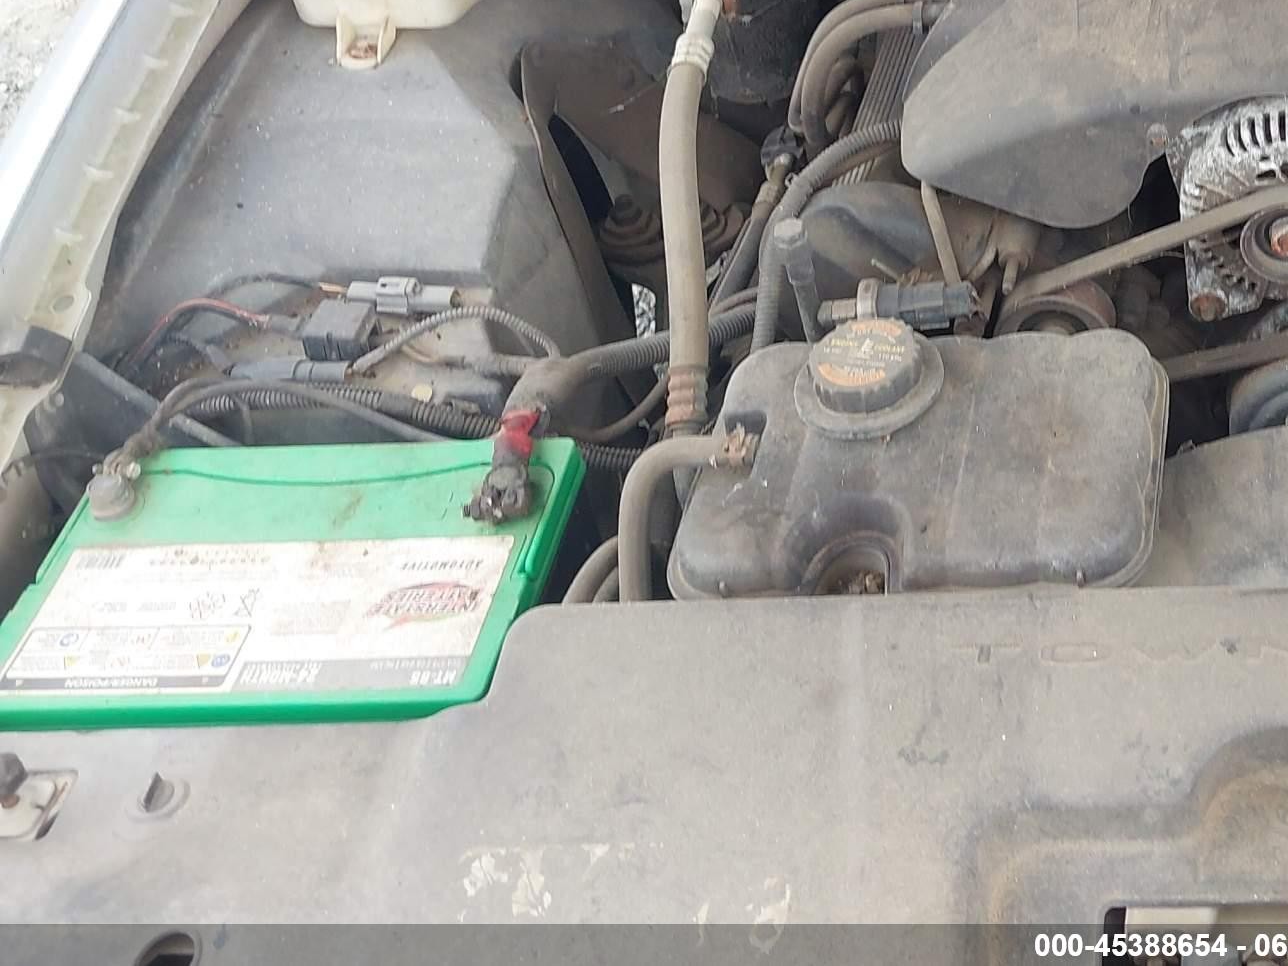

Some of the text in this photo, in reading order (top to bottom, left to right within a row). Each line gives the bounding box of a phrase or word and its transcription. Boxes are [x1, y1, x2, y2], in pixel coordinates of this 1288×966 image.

[400, 557, 485, 572] AUTOMOTIVE
[383, 585, 482, 603] BATTERIES
[365, 600, 480, 620] INTERSTATE
[239, 669, 320, 685] 24-MONTH
